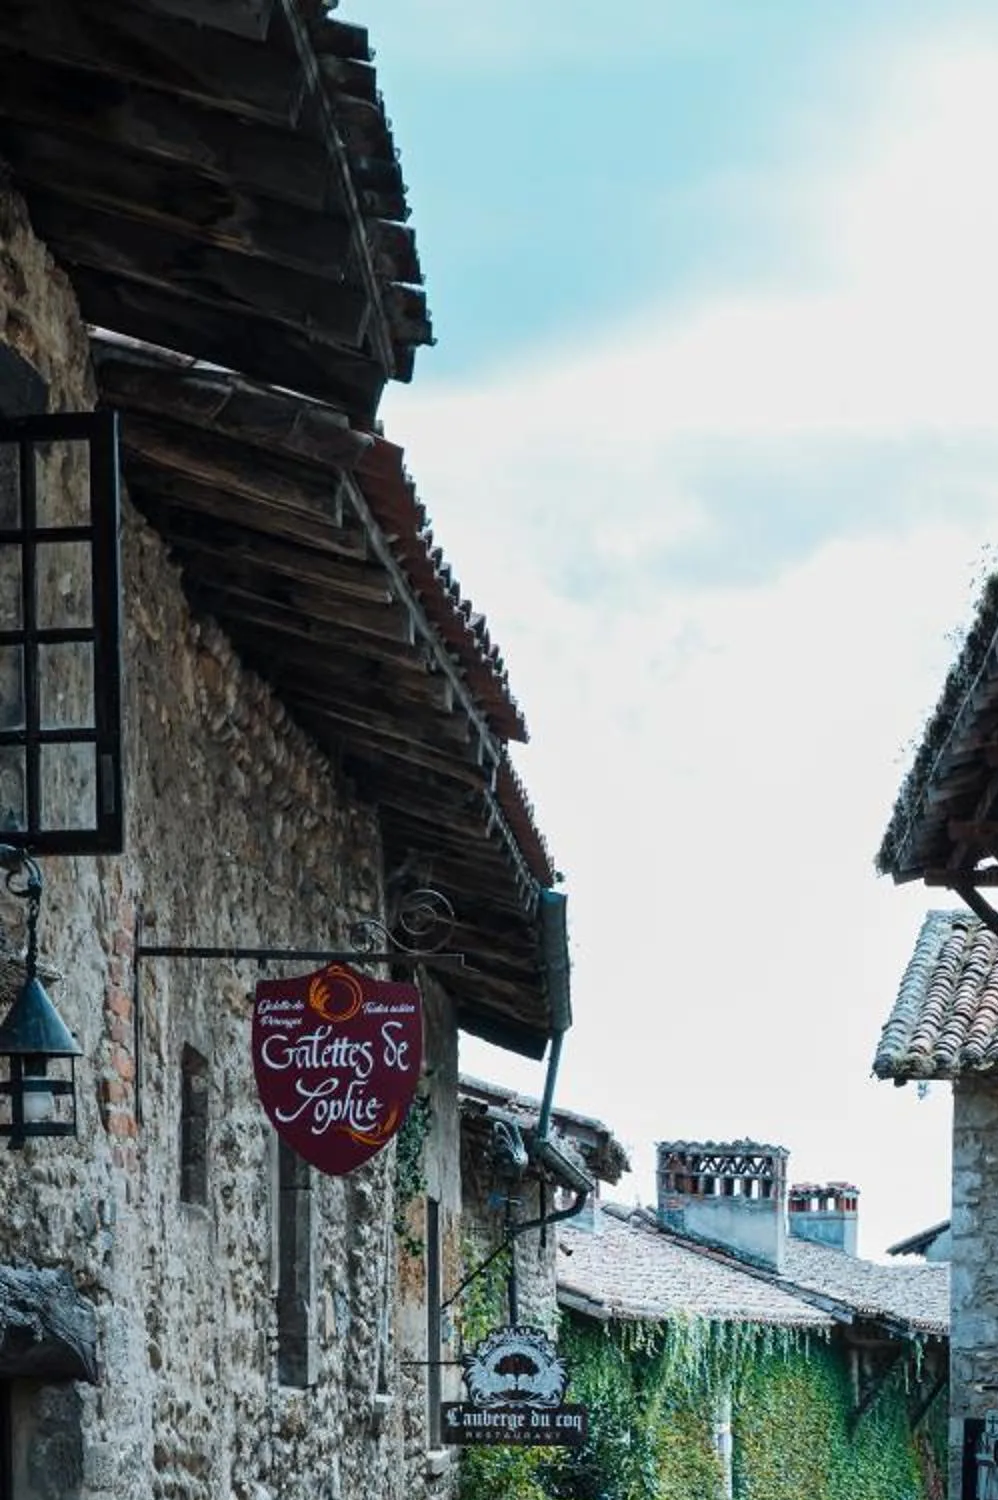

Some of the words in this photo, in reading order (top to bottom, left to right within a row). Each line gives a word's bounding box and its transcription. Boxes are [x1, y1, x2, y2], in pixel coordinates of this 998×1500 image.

[261, 1025, 374, 1078] Galettes
[381, 1021, 409, 1071] de
[275, 1077, 384, 1135] Sophie
[445, 1404, 525, 1431] L'auberge
[531, 1409, 551, 1427] du
[555, 1412, 583, 1433] coq
